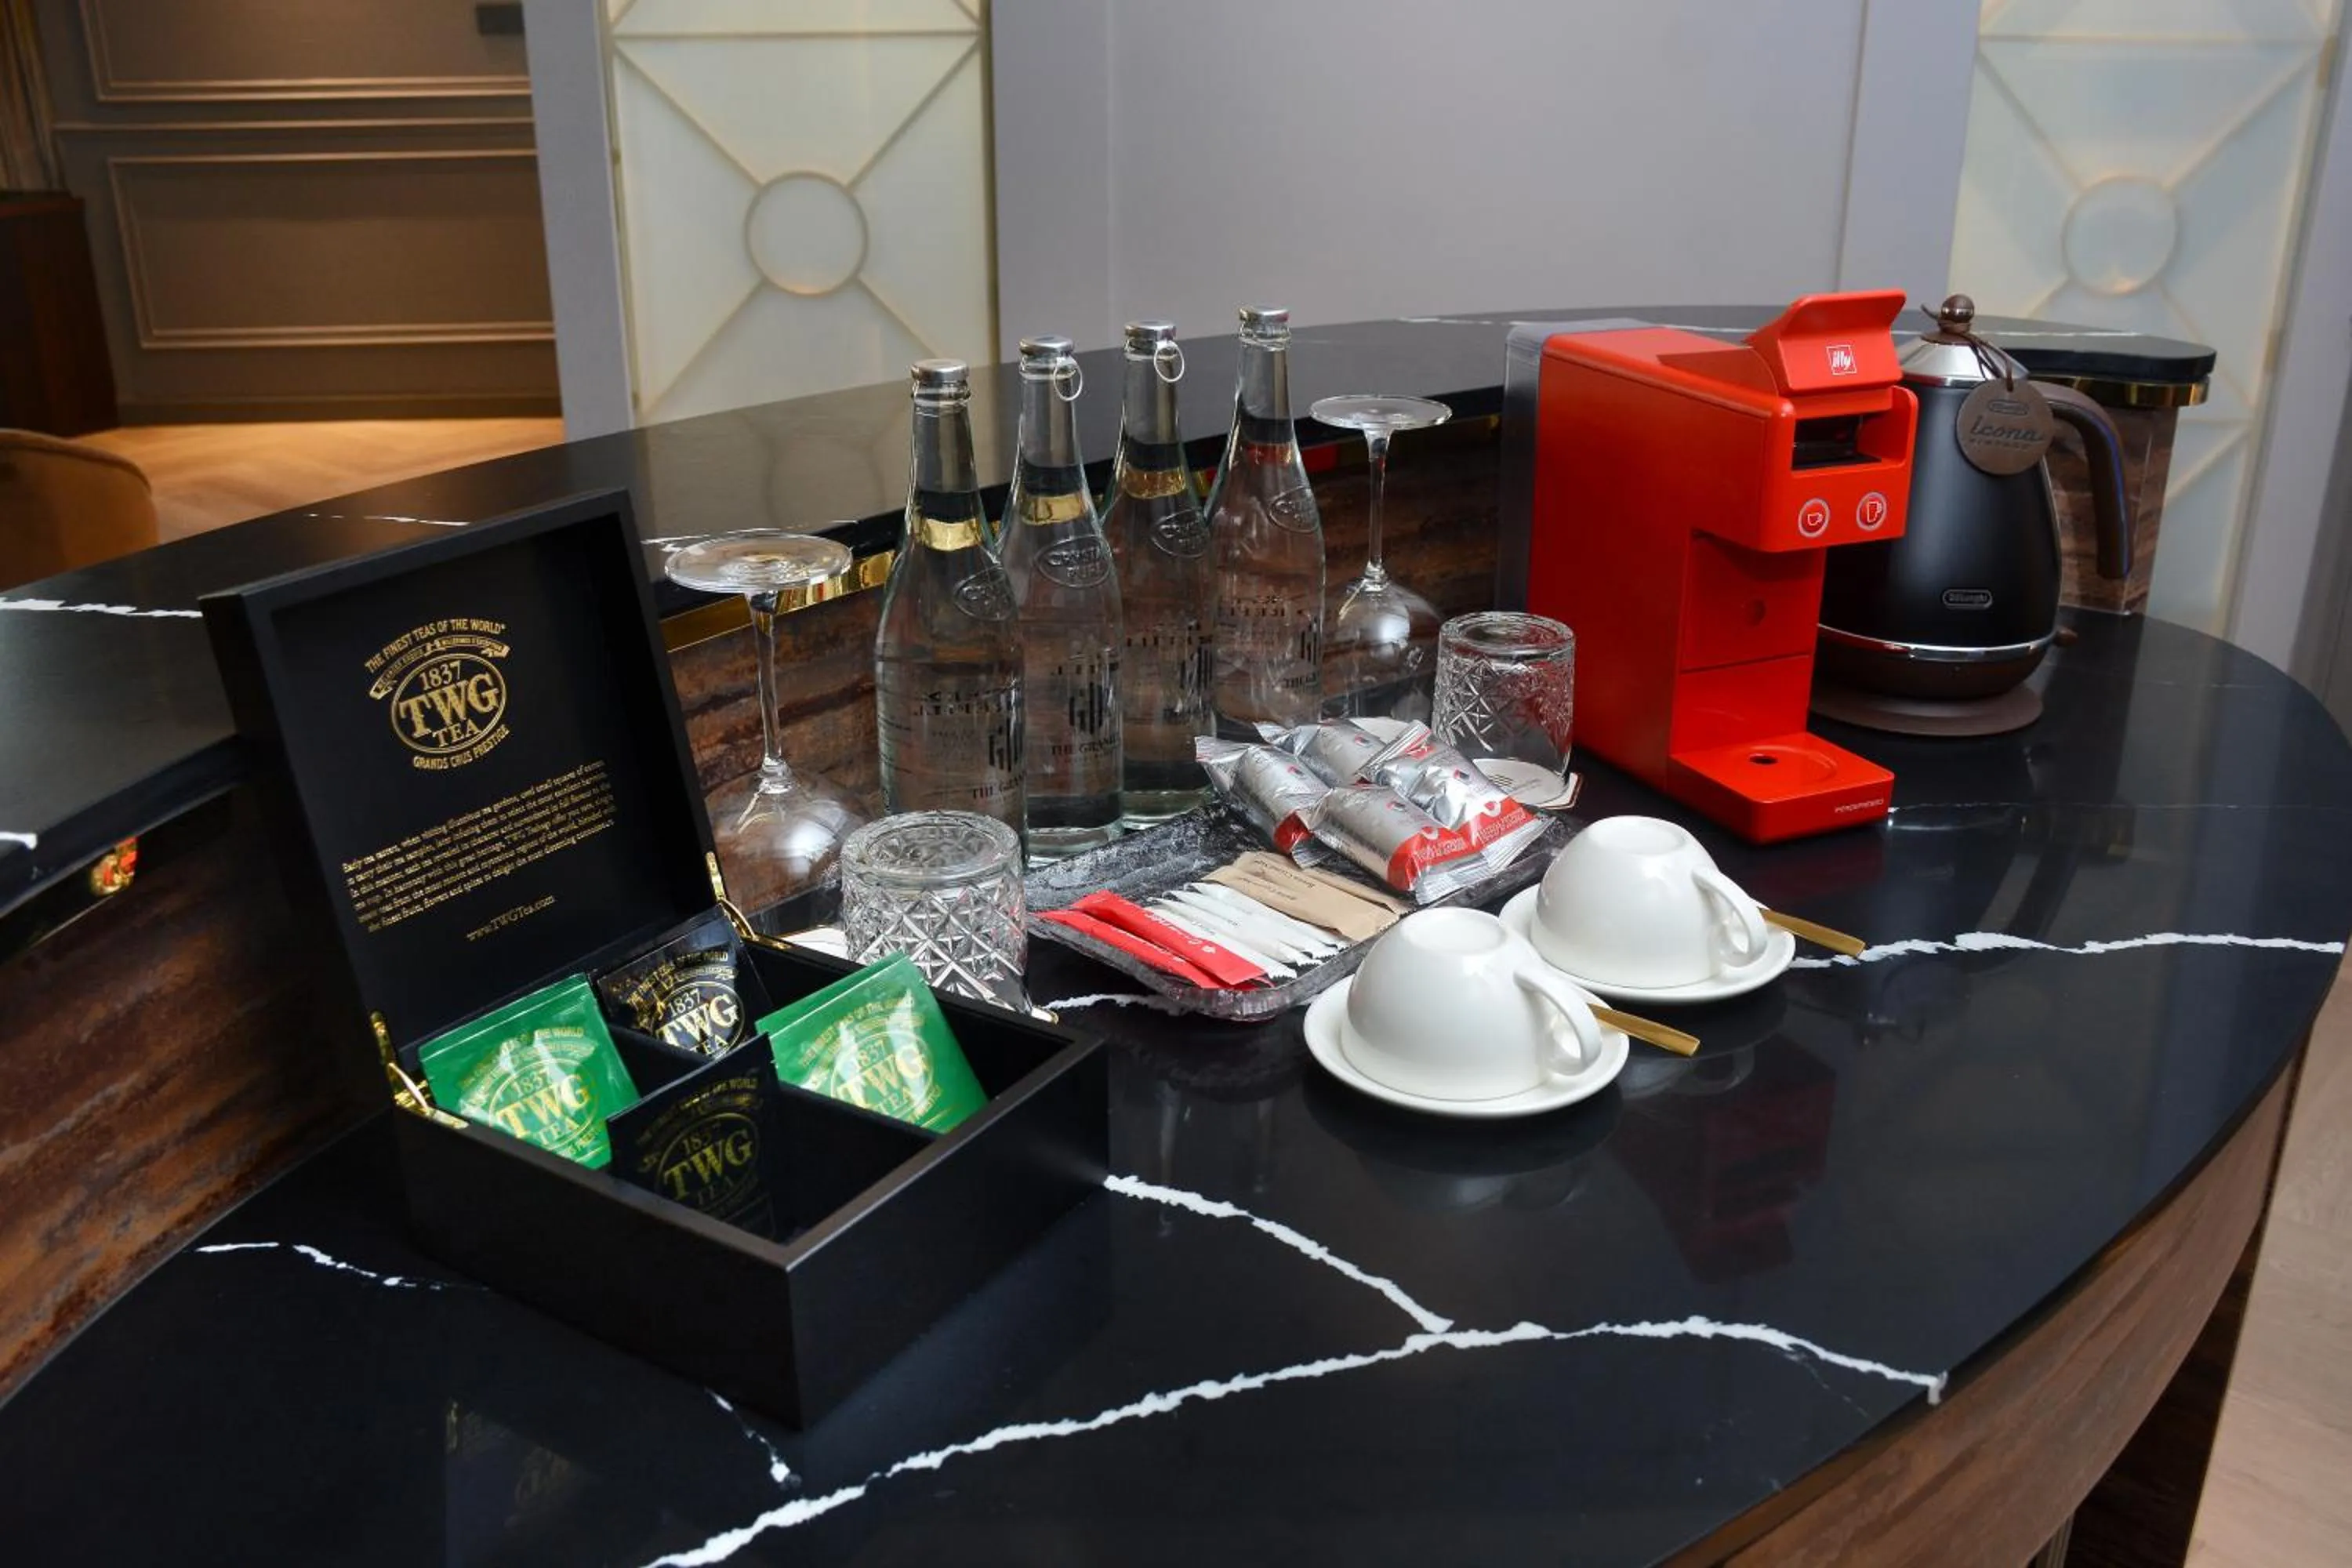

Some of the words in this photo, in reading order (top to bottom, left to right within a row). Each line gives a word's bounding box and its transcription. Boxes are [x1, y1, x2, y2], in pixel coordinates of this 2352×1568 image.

[1833, 350, 1851, 371] illy
[365, 658, 384, 673] THE
[382, 633, 413, 659] FINEST
[412, 623, 436, 641] TEAS
[437, 621, 449, 633] OF
[451, 618, 469, 631] THE
[419, 659, 462, 691] 1837
[398, 672, 500, 739] TWG
[412, 755, 449, 771] GRANDS
[449, 750, 473, 768] CRUS
[472, 724, 510, 759] PRESTIGE
[432, 719, 481, 747] TEA
[655, 994, 739, 1047] TWG
[667, 988, 701, 1017] 1837
[511, 1067, 550, 1097] 1837
[837, 1044, 927, 1108] TWG
[495, 1073, 590, 1139] TWG
[537, 1116, 580, 1146] TEA
[662, 1128, 754, 1201] TWG
